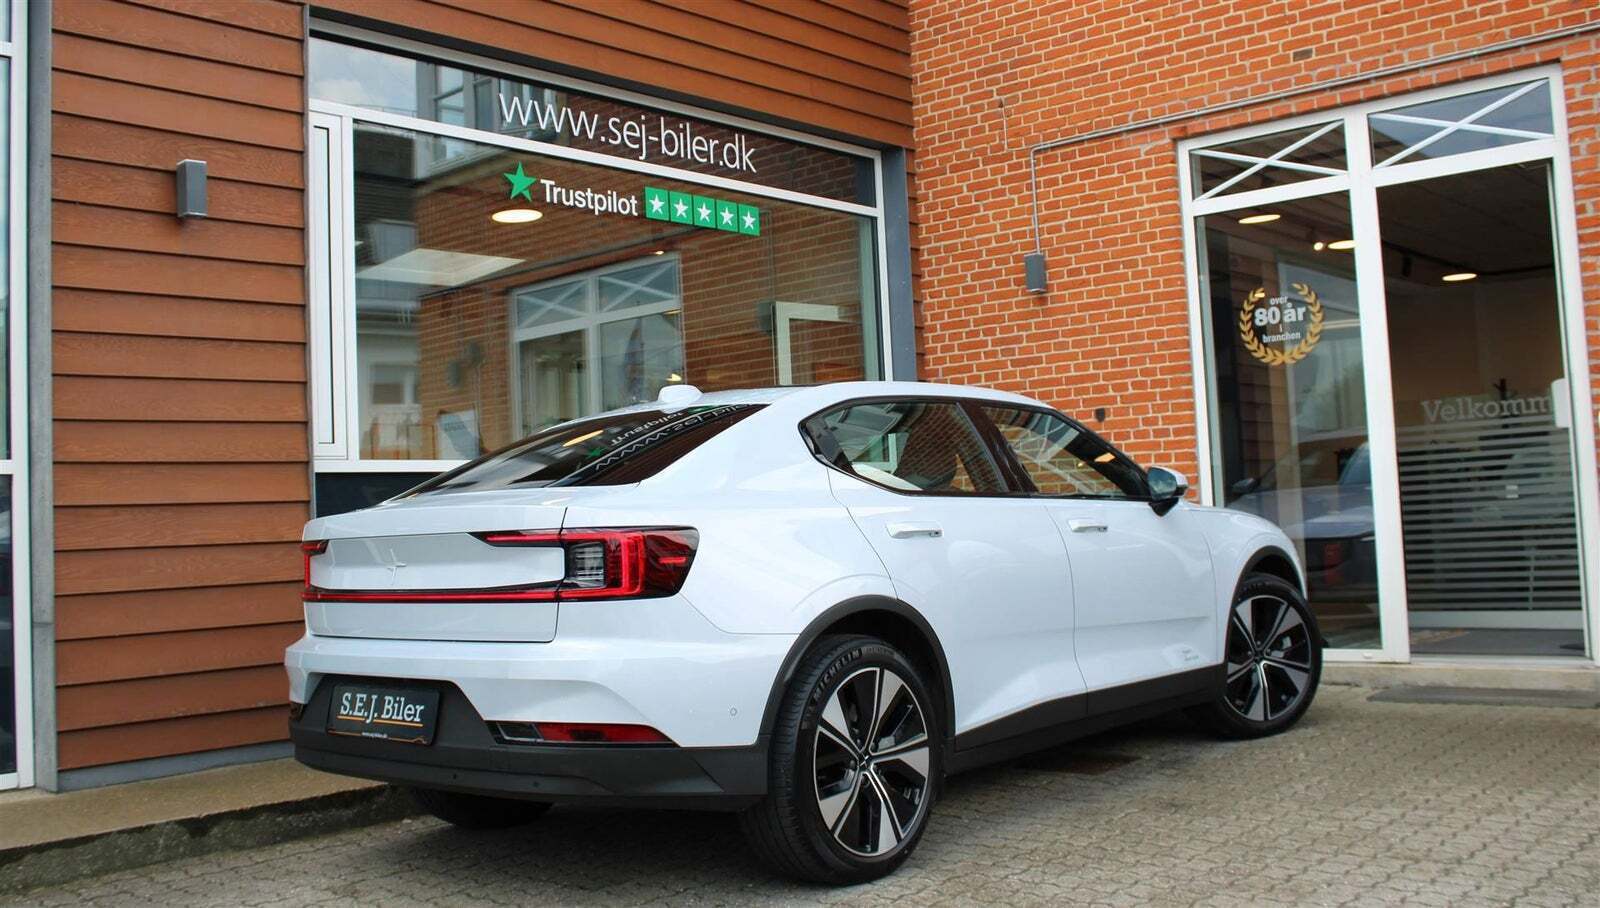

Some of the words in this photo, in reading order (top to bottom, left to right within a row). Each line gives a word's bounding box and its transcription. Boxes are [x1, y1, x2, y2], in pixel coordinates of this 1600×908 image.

[499, 93, 757, 173] www.sej-biler.dk
[540, 178, 638, 216] Trustpilot
[1254, 306, 1280, 326] 80
[1283, 302, 1306, 322] år
[1270, 296, 1288, 305] over
[1262, 332, 1301, 343] branchen
[340, 692, 378, 723] S.E.J.
[381, 695, 424, 722] Biler
